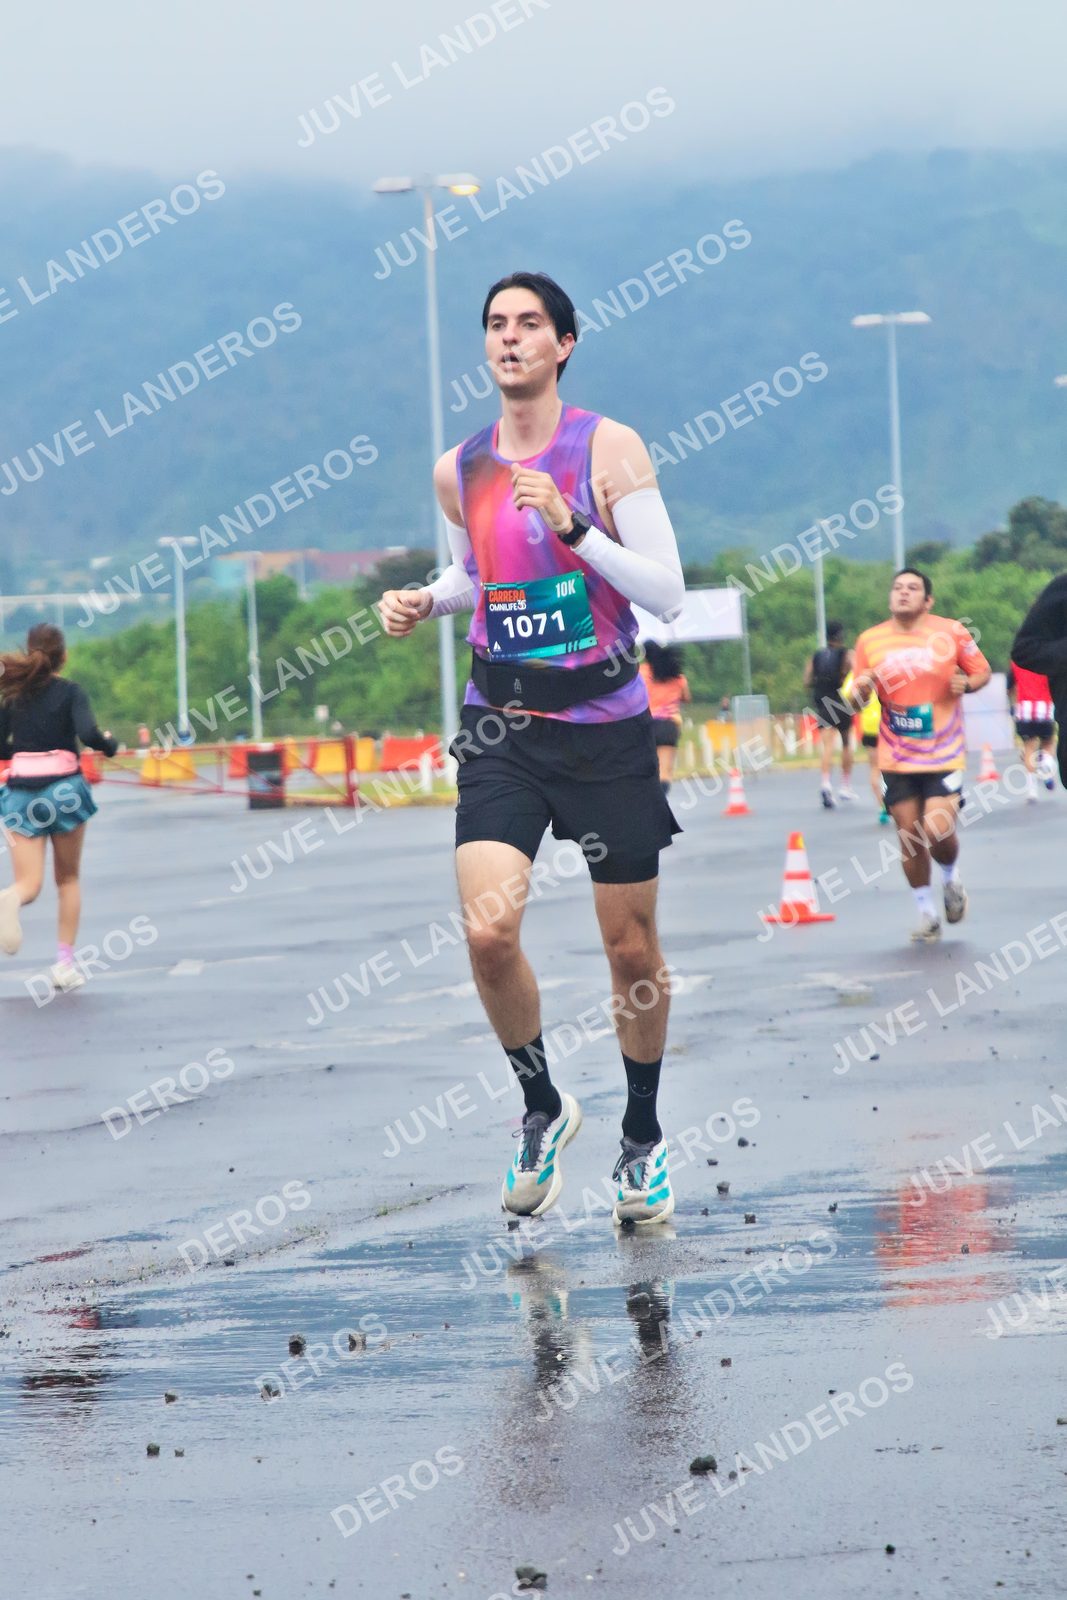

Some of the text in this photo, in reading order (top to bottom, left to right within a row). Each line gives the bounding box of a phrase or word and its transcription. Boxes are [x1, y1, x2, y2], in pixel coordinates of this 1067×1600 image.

[489, 590, 526, 602] CARRERA
[556, 579, 576, 598] 10K
[489, 603, 517, 612] OMNILIFE
[503, 610, 565, 638] 1071
